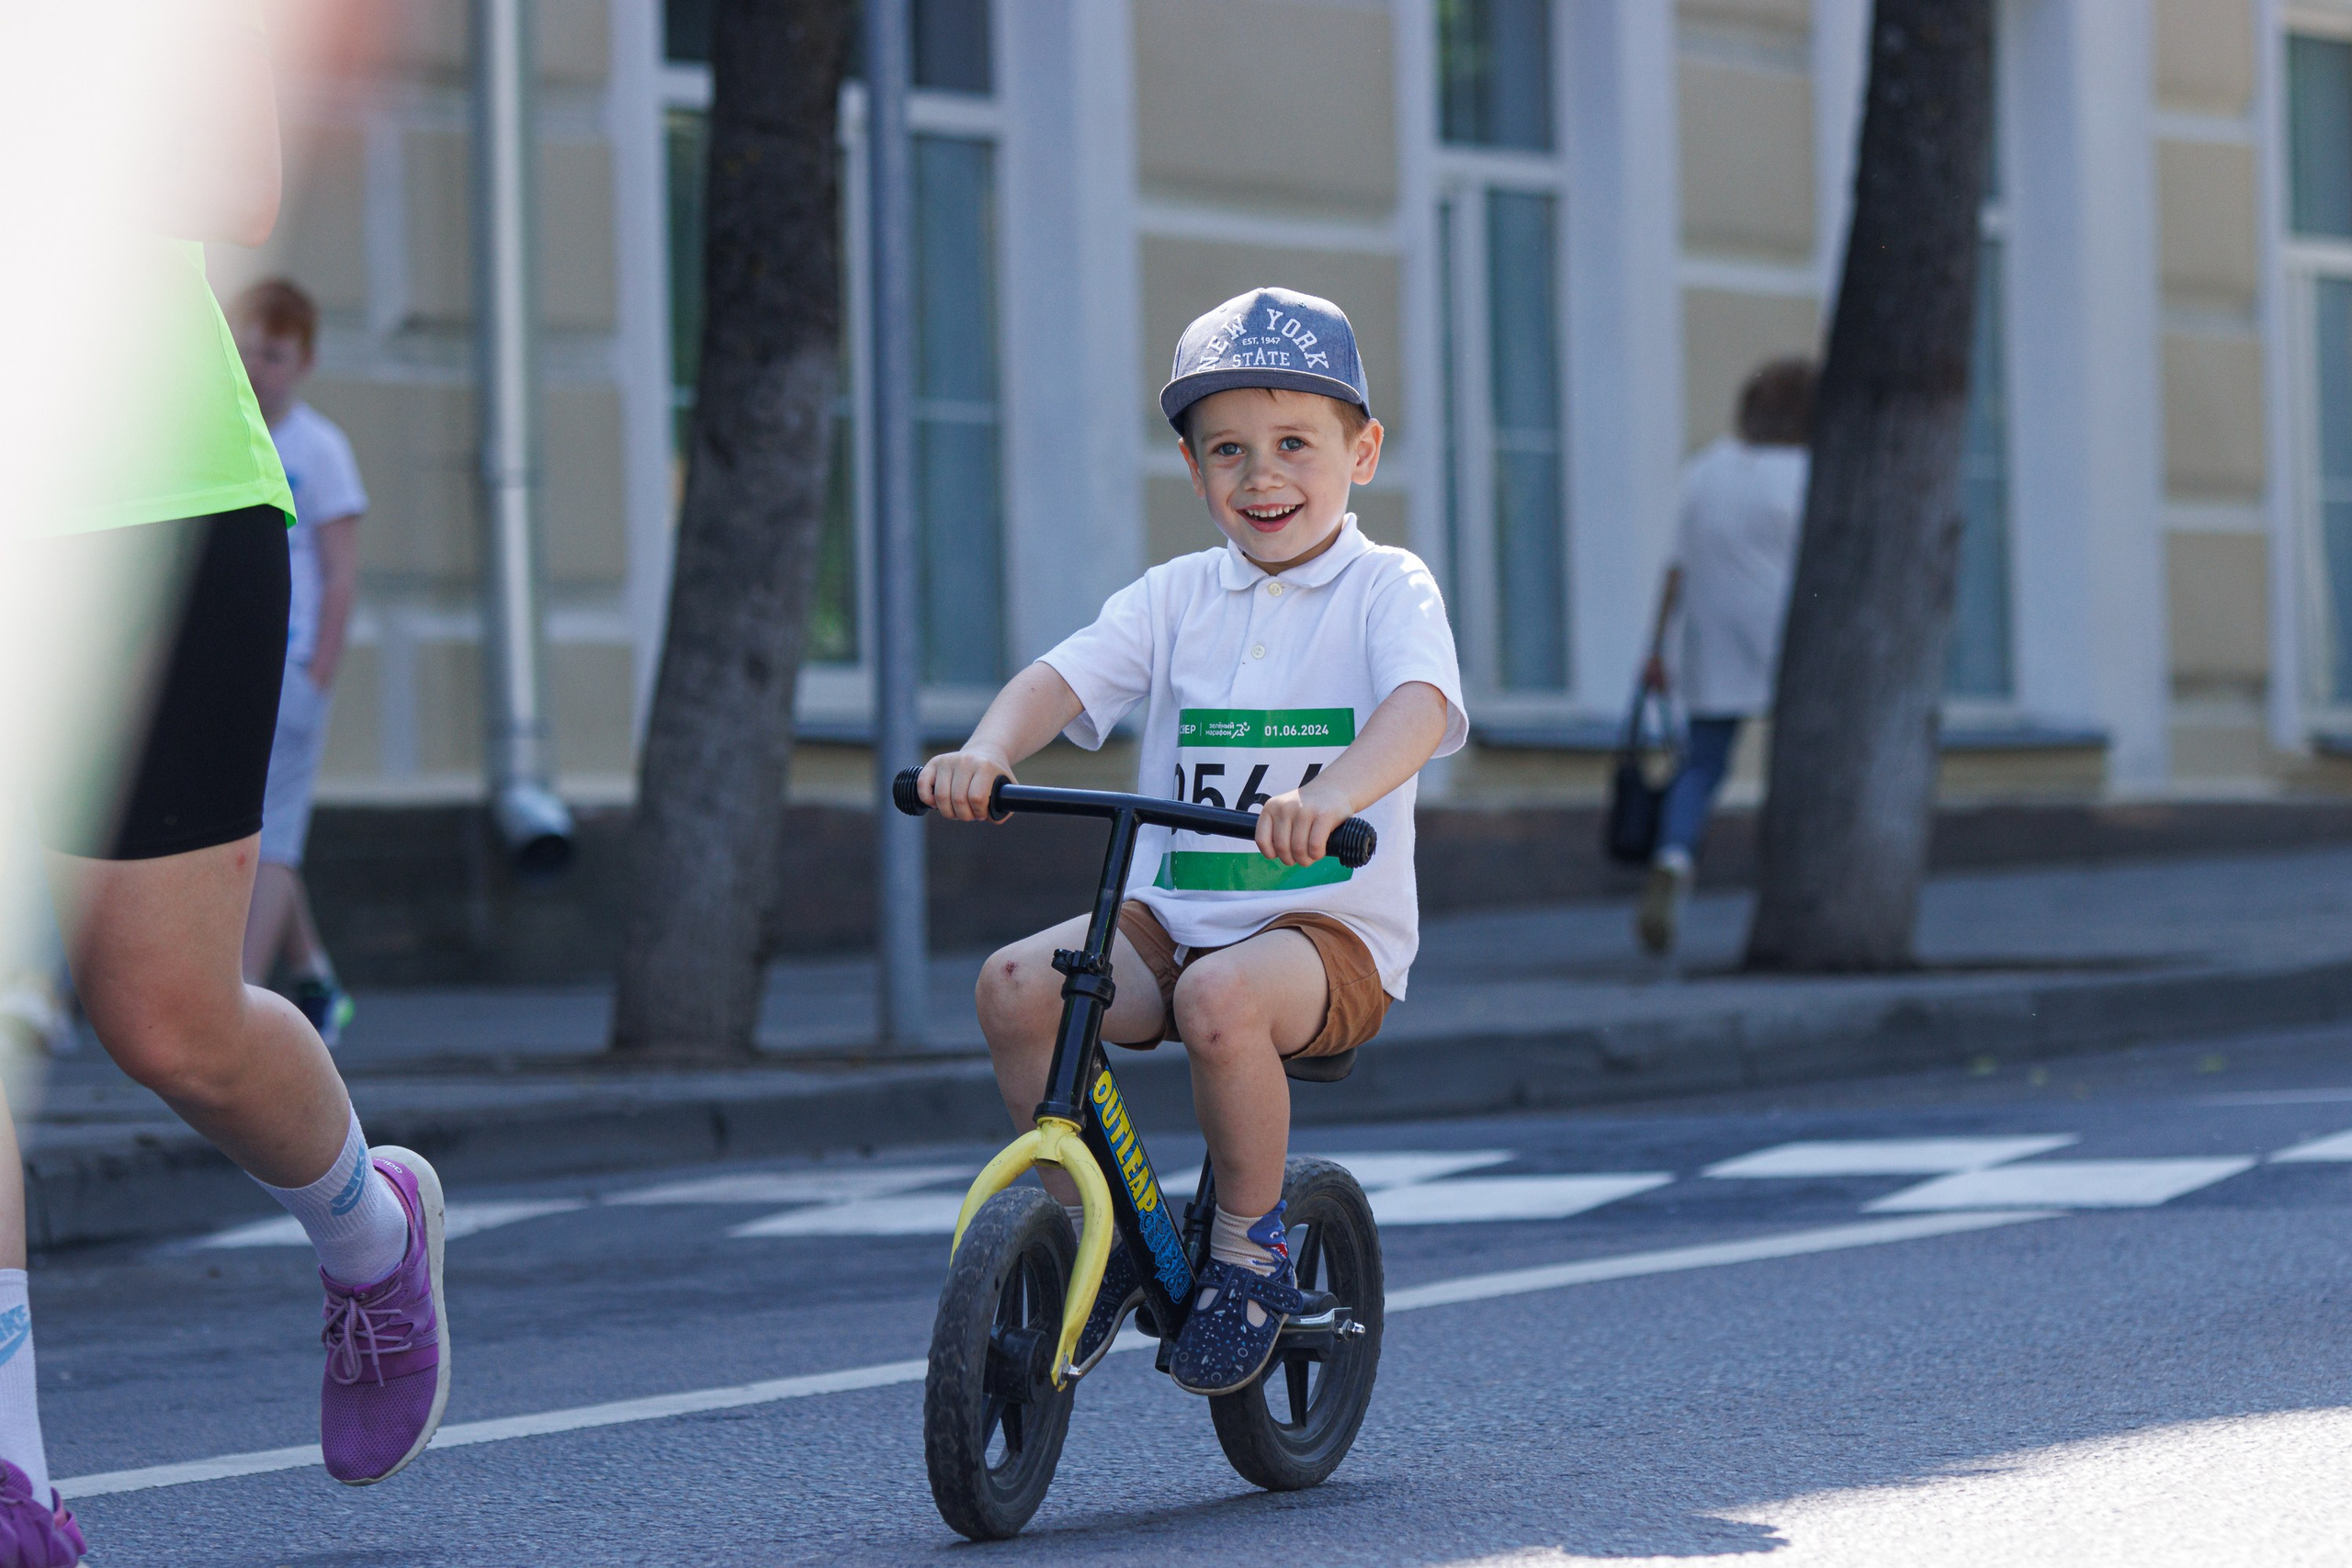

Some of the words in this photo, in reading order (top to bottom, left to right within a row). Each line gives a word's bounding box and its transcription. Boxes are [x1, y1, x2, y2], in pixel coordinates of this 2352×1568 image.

[1196, 313, 1248, 372] NEW
[1266, 308, 1329, 369] YORK
[1242, 337, 1259, 345] EST.
[1261, 336, 1281, 344] 1947
[1232, 347, 1291, 367] STATE
[1264, 724, 1329, 737] 01.06.2024
[1092, 1069, 1158, 1213] OUTLEAP
